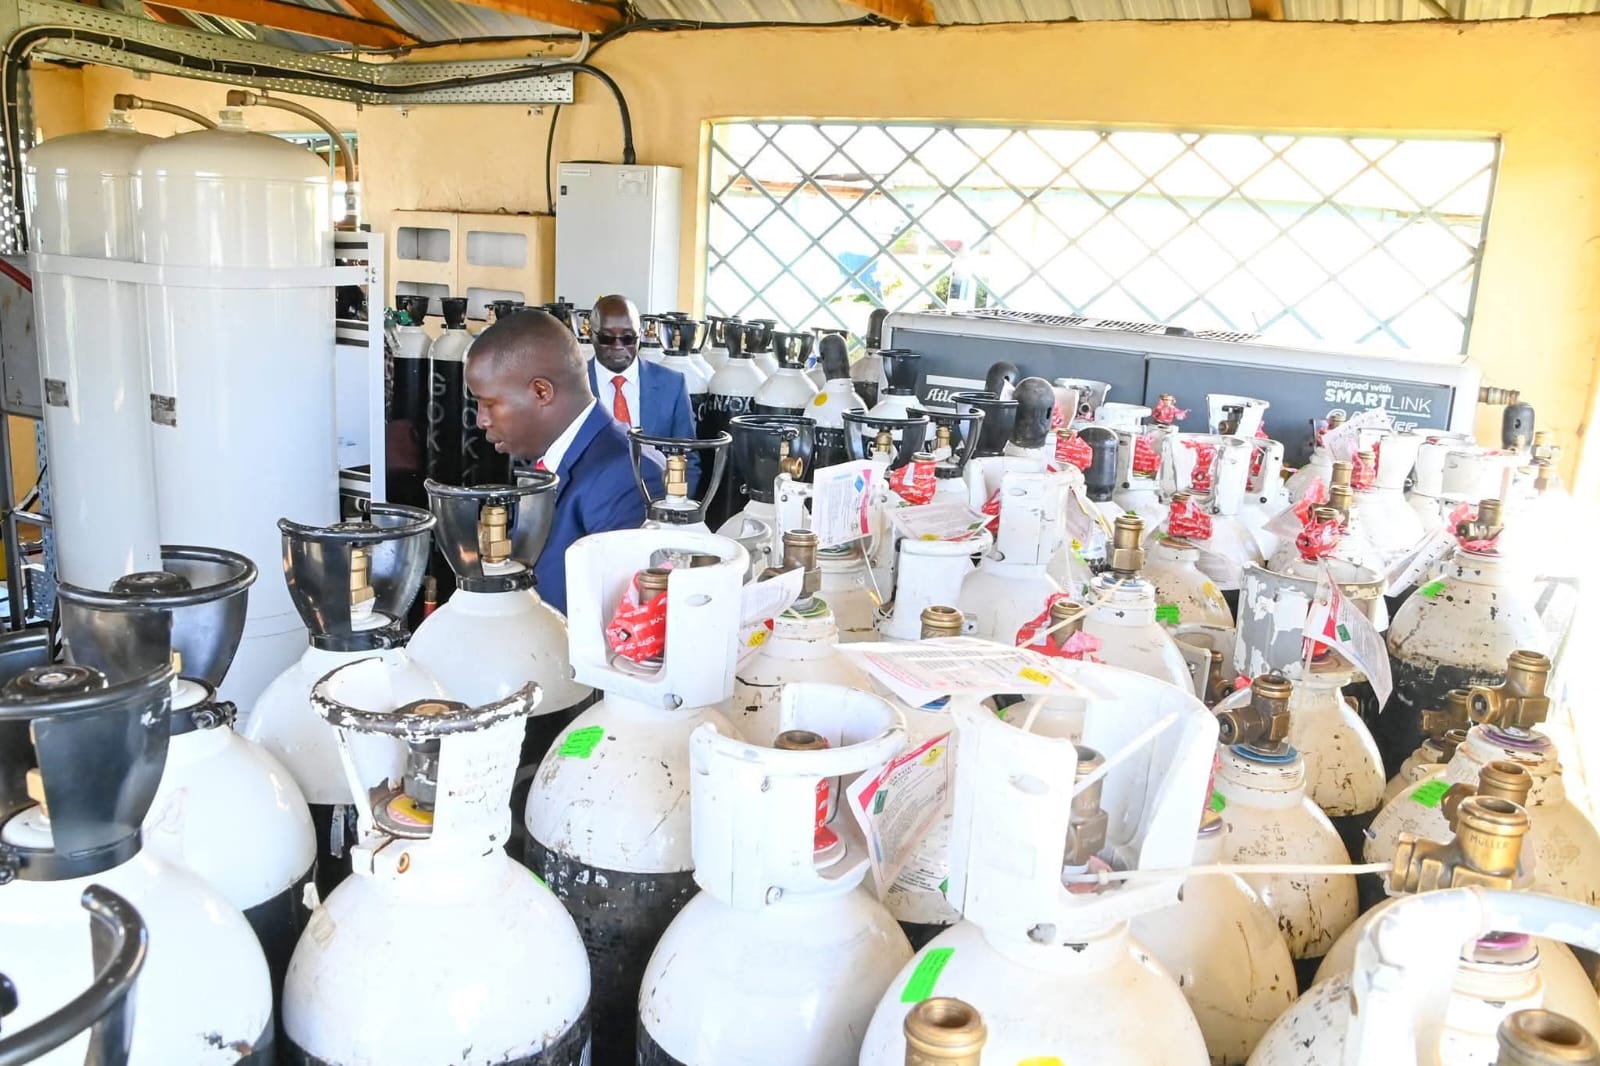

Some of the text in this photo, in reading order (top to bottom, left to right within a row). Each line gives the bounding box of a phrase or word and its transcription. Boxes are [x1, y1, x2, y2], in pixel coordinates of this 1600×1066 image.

[1326, 379, 1392, 393] equipped with
[1325, 389, 1431, 412] SMARTLINK
